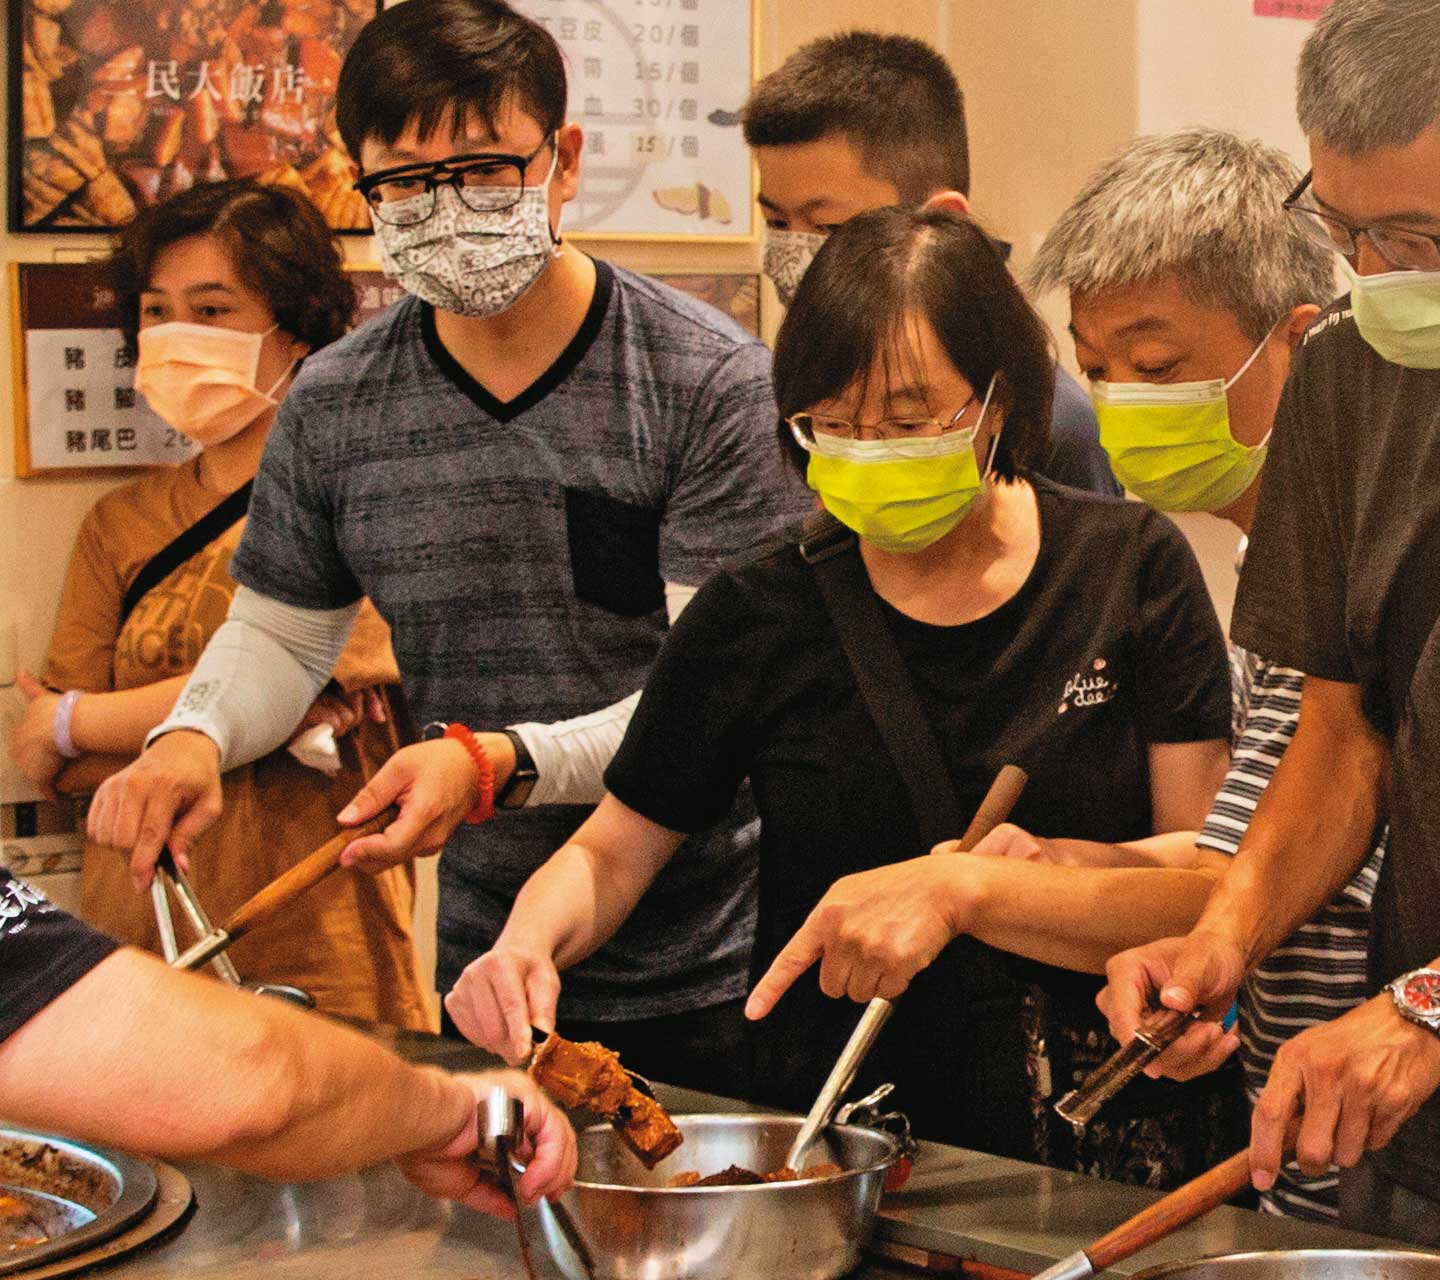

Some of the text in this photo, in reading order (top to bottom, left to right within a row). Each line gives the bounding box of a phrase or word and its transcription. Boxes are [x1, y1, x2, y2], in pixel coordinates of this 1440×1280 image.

[583, 93, 604, 117] 血
[64, 427, 138, 453] 豬尾巴
